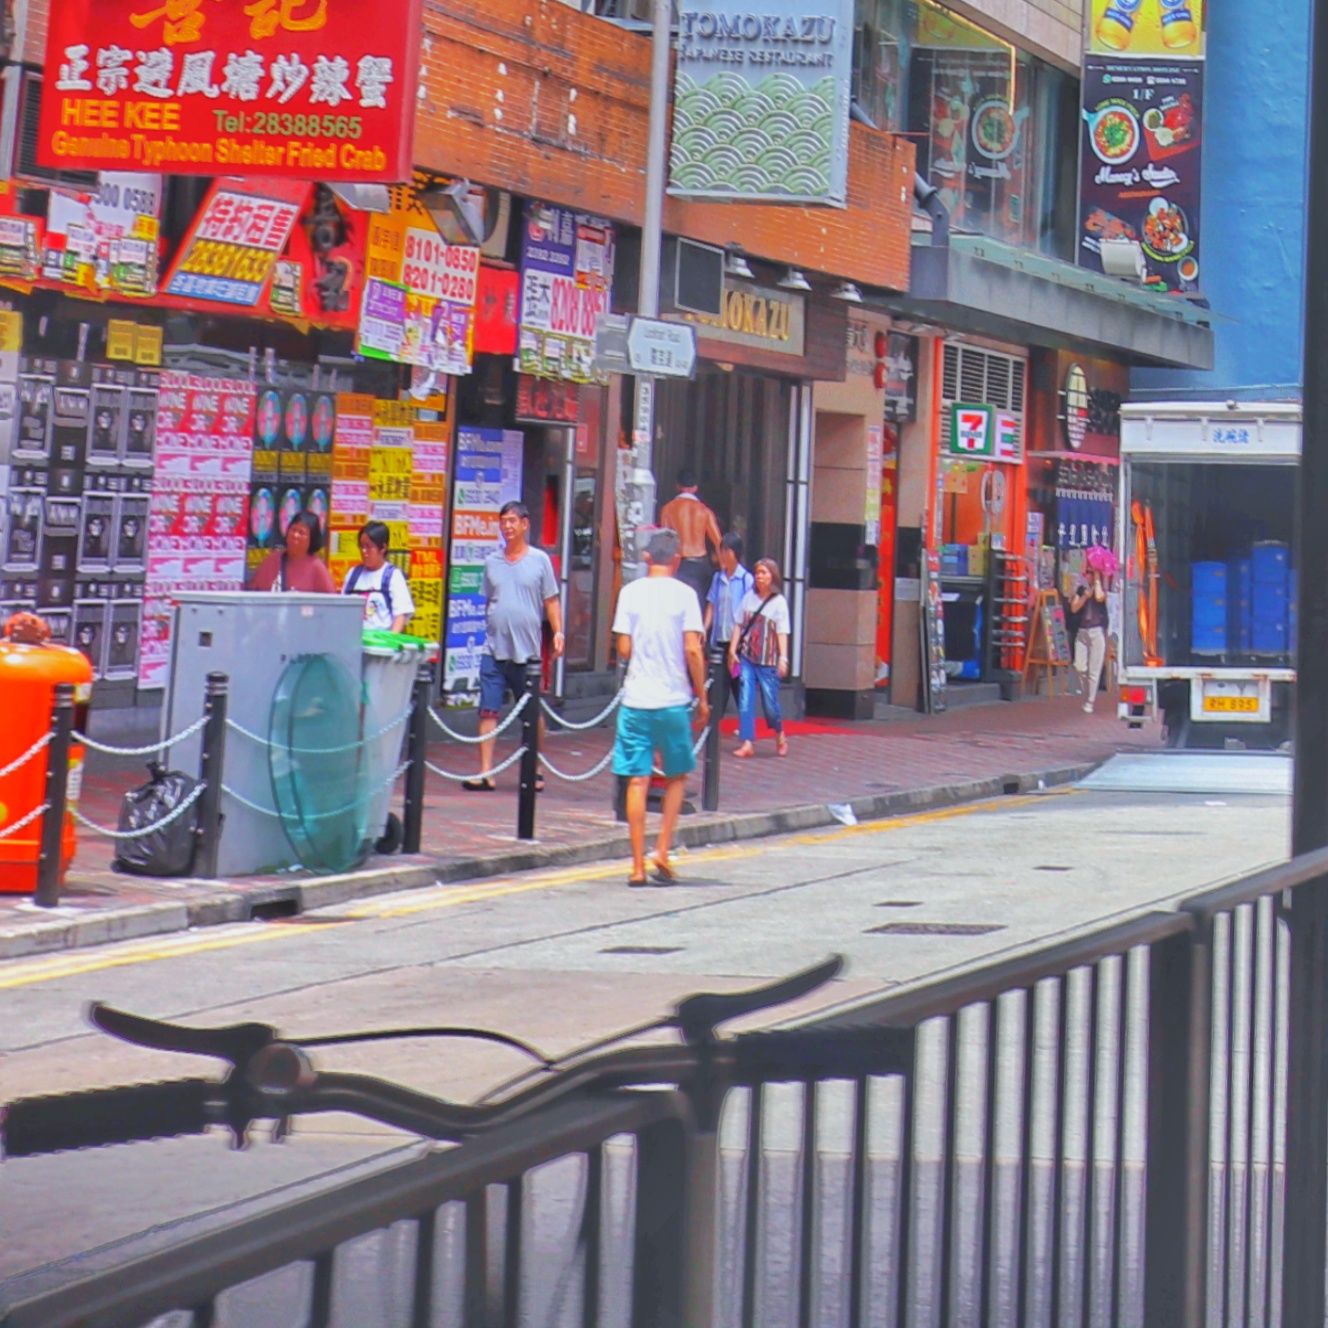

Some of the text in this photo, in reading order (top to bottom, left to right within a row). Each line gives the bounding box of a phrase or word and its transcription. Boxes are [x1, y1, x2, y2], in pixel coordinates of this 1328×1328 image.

[678, 12, 836, 45] TOMOKAZU
[62, 98, 182, 132] HEE KEE
[213, 109, 363, 140] Tel:28388565
[51, 130, 388, 172] Genuine Typhoon Shelter Fried Crab
